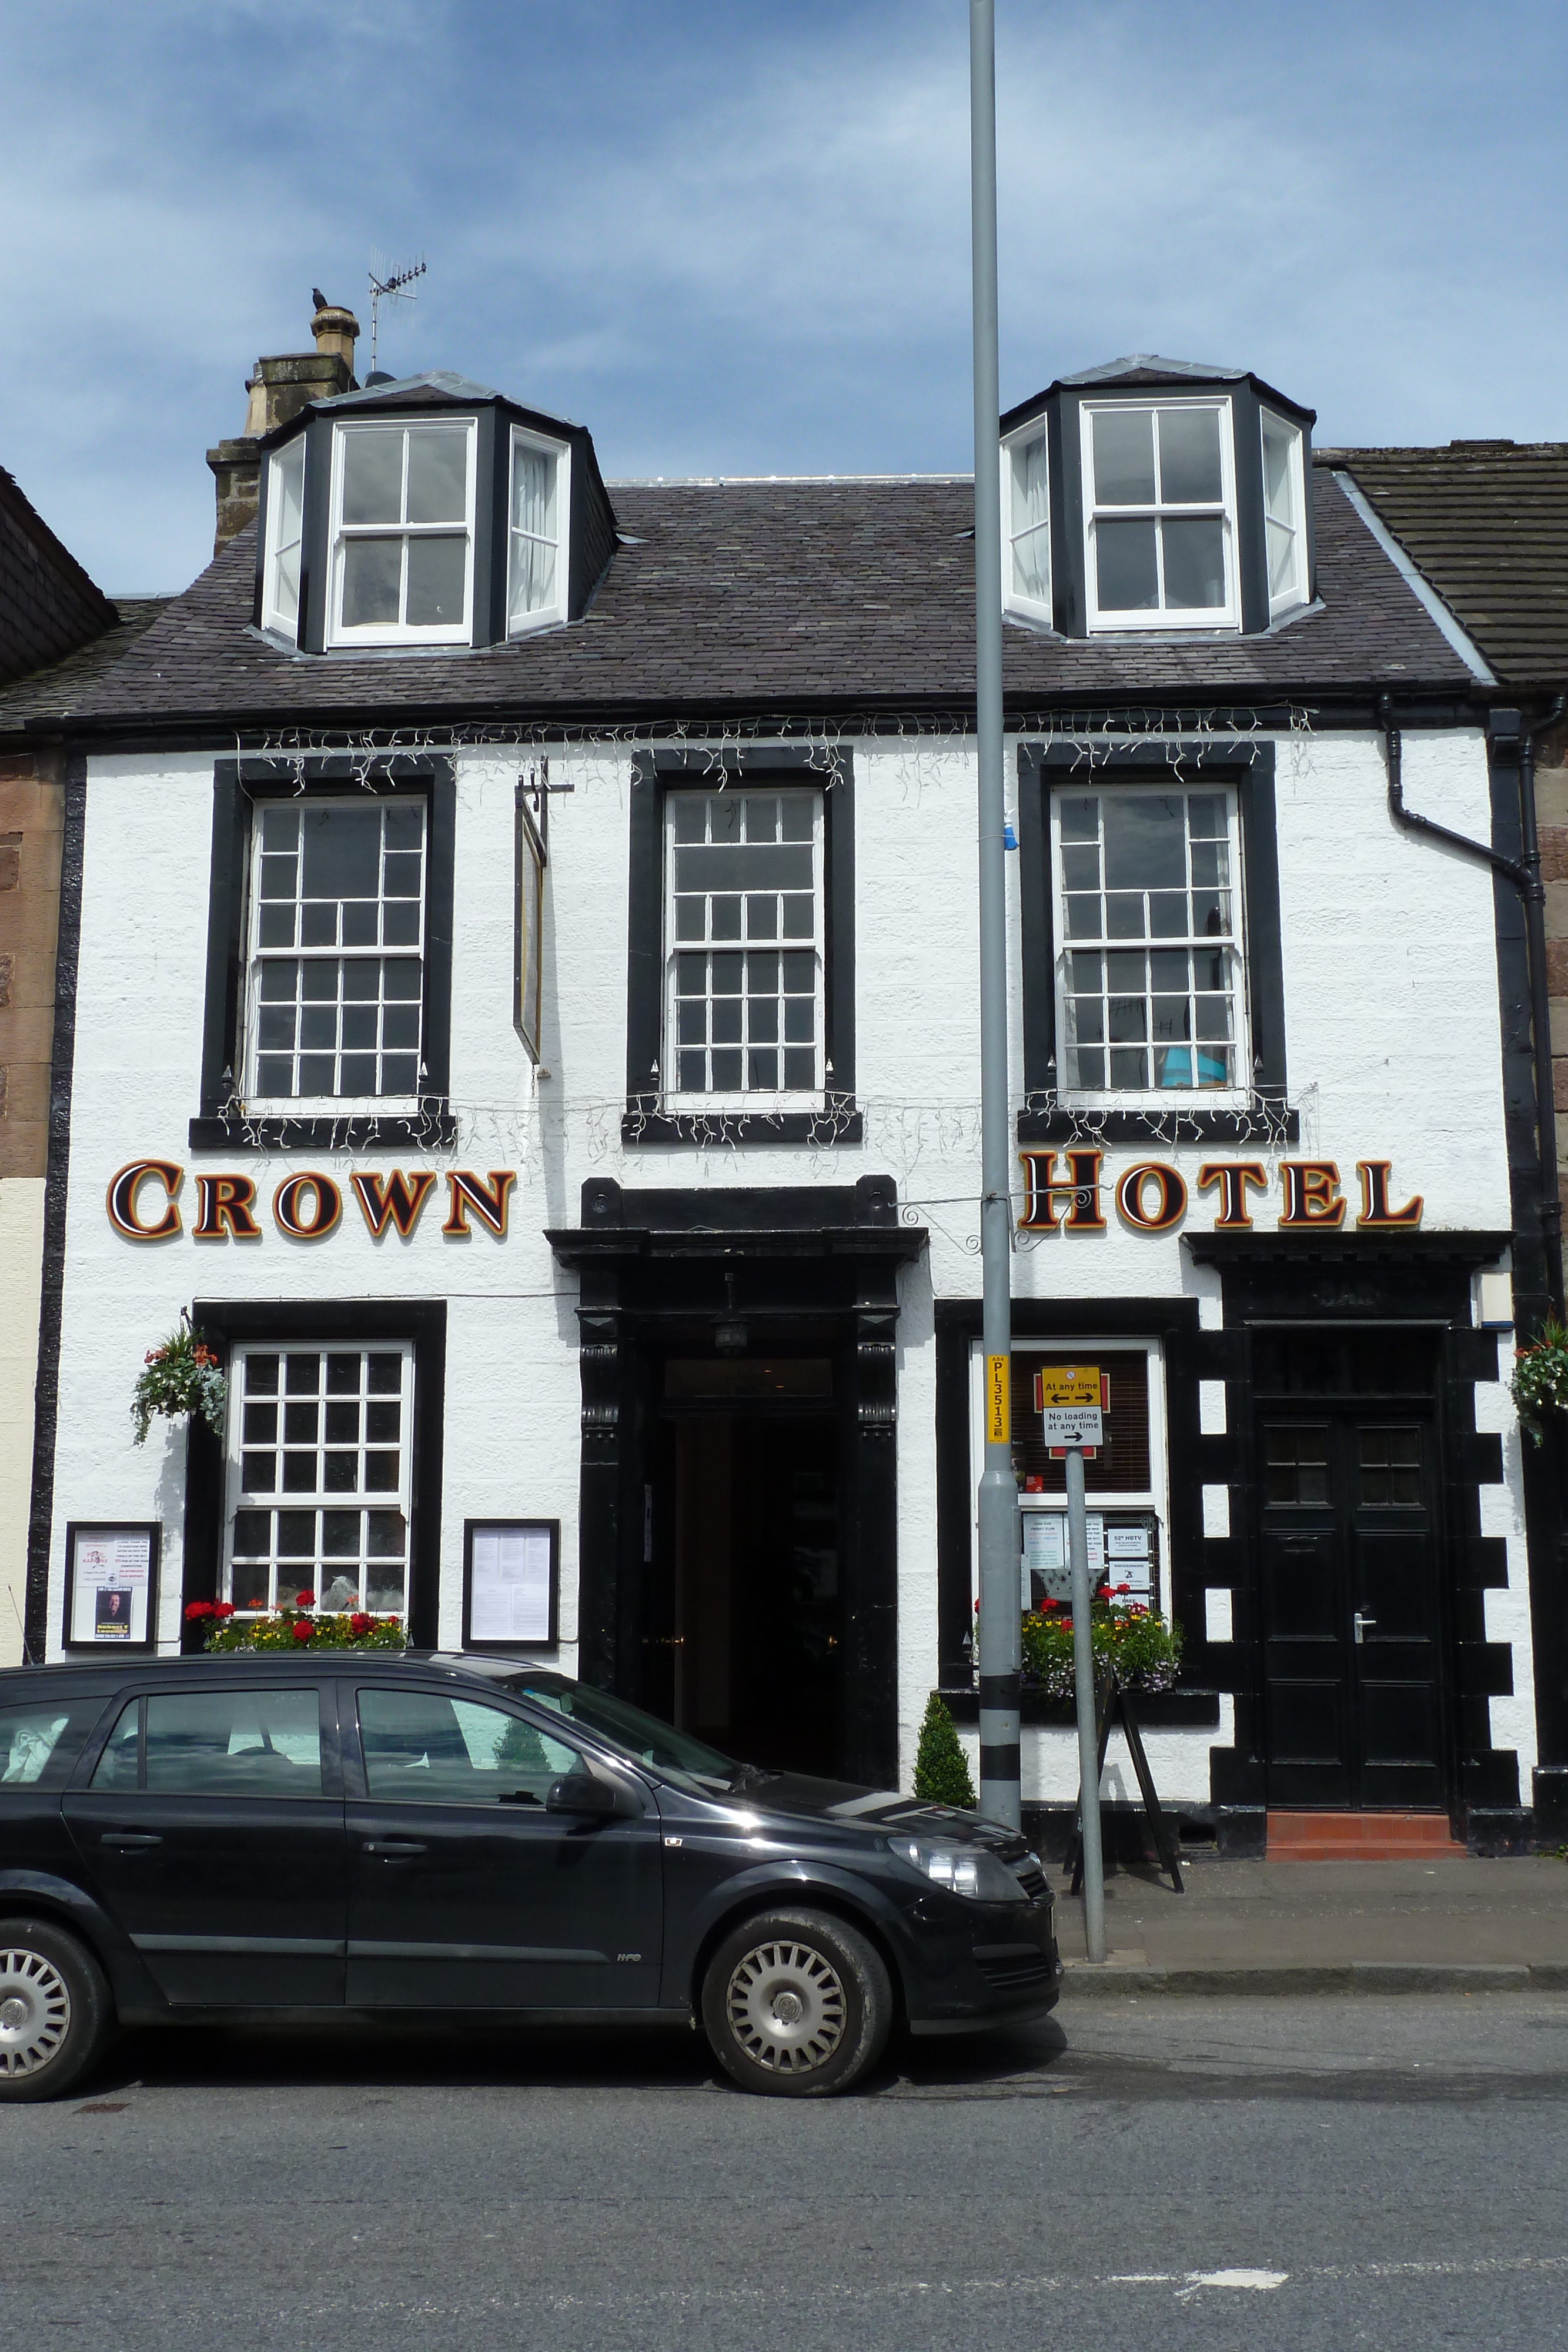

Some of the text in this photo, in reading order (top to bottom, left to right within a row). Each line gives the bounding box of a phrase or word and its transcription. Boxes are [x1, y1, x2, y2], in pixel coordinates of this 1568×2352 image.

[106, 1149, 1424, 1240] CROWN HOTEL
[1049, 1412, 1098, 1421] No loading
